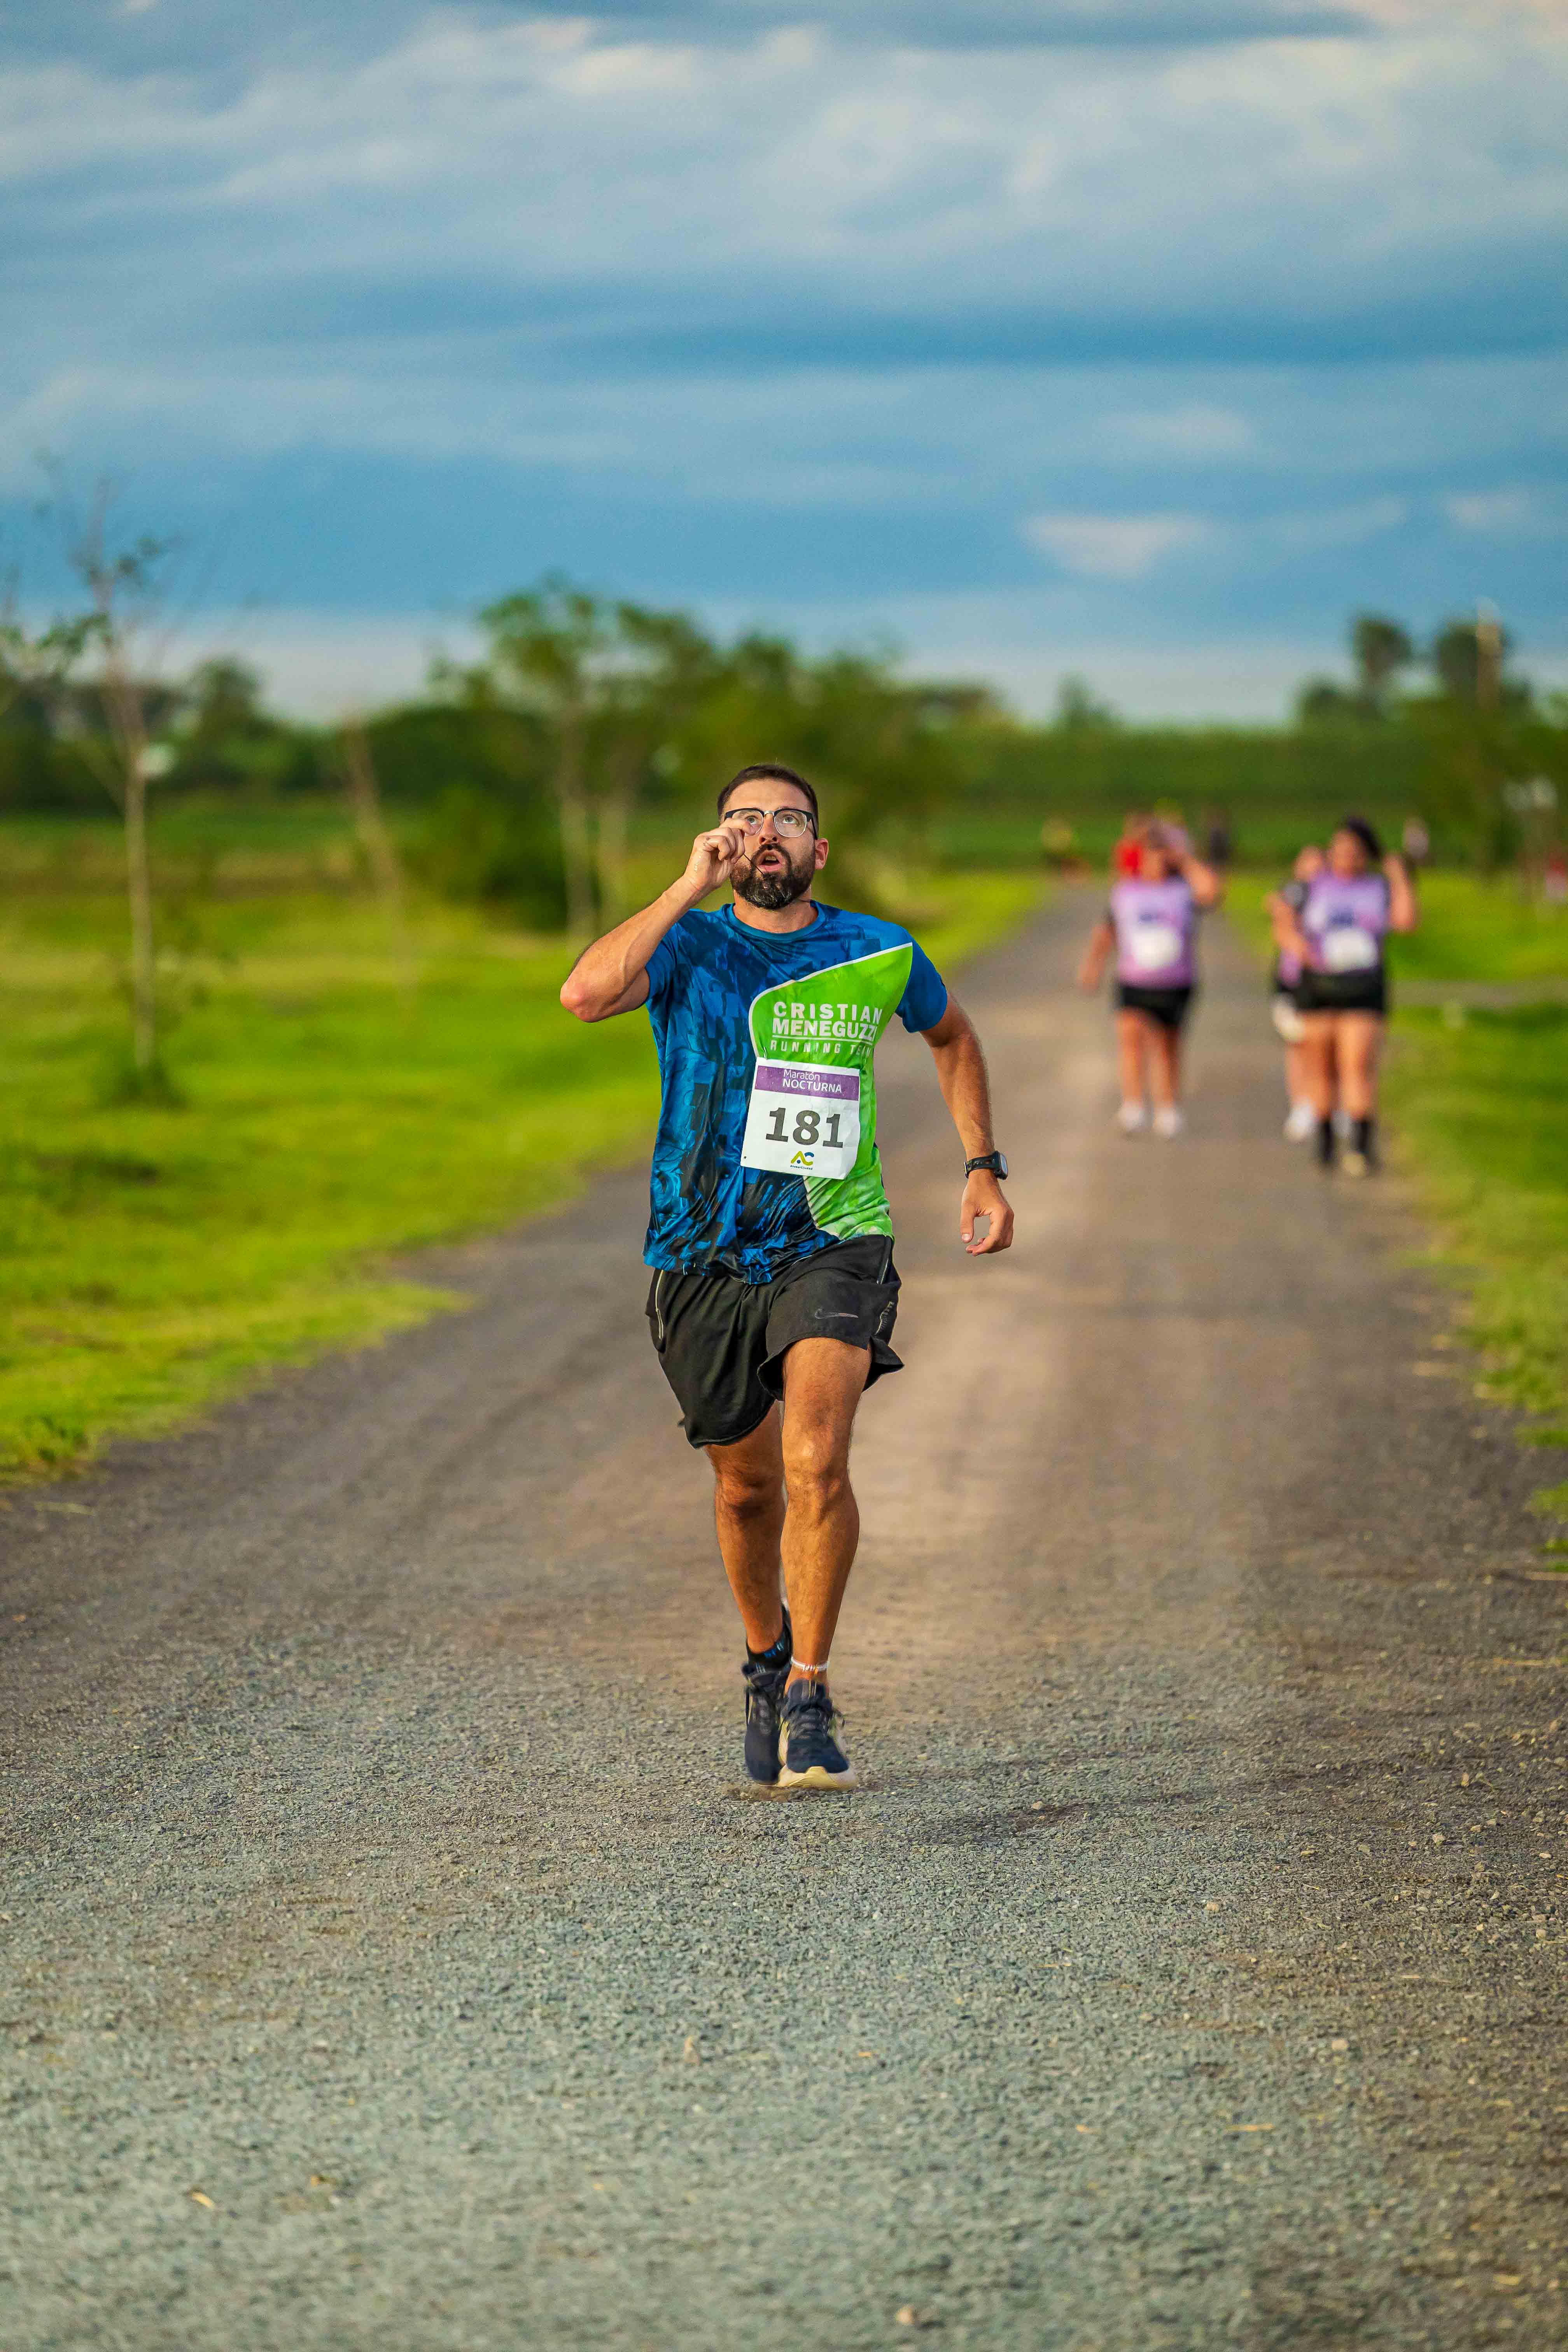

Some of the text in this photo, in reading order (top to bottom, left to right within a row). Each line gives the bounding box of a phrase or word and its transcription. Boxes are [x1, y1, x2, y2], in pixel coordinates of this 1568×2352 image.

[774, 1001, 882, 1024] CRISTIAN
[772, 1018, 877, 1041] MENEGUZZI
[770, 1040, 840, 1053] RUNNING
[783, 1069, 820, 1081] Maratón
[782, 1078, 842, 1092] NOCTURNA
[765, 1107, 843, 1148] 181
